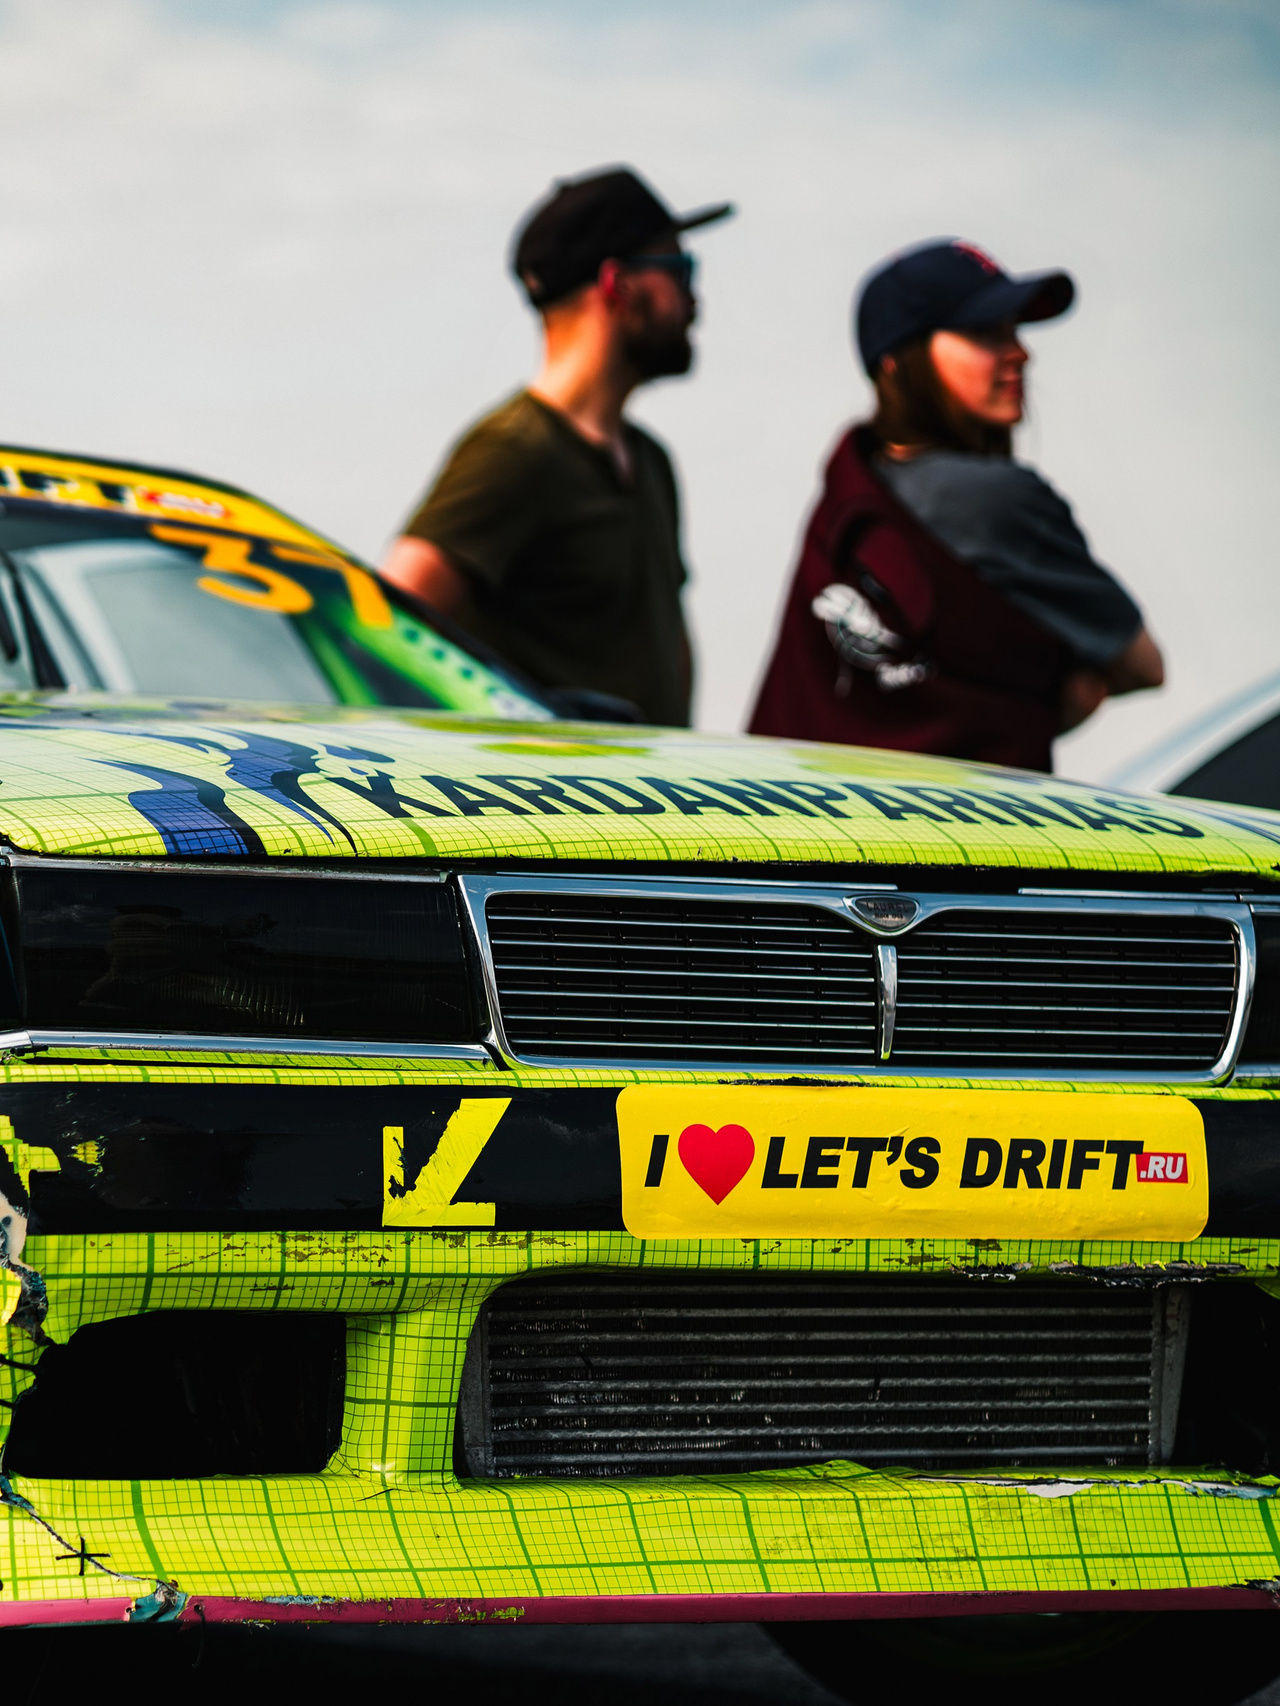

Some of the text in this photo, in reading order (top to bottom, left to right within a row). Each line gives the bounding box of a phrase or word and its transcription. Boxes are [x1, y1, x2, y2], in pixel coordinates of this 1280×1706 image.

[326, 769, 1206, 839] KARDANPARNAS
[643, 1134, 670, 1188] I
[761, 1135, 941, 1189] LET'S
